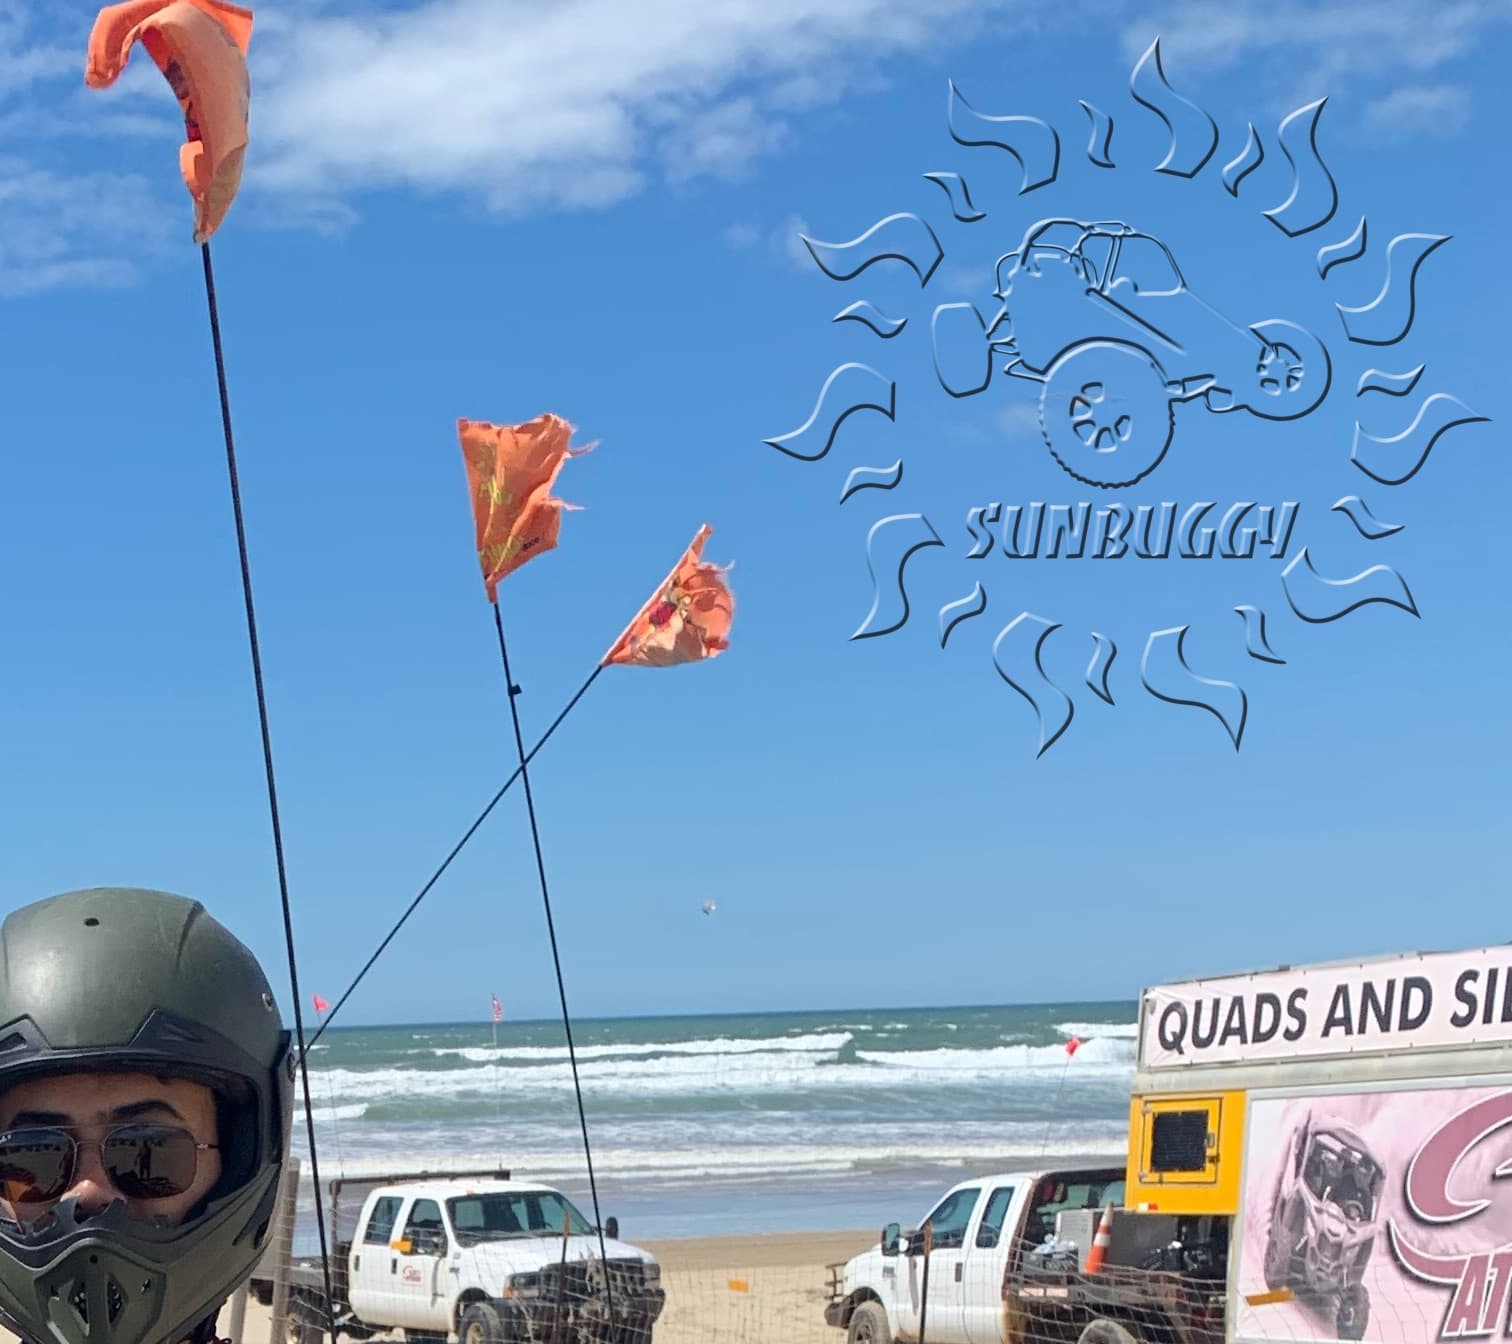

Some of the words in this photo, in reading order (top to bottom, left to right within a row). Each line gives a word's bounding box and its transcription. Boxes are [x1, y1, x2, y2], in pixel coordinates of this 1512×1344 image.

[1158, 987, 1308, 1055] QUADS
[1321, 975, 1432, 1038] AND
[1450, 965, 1512, 1028] SI
